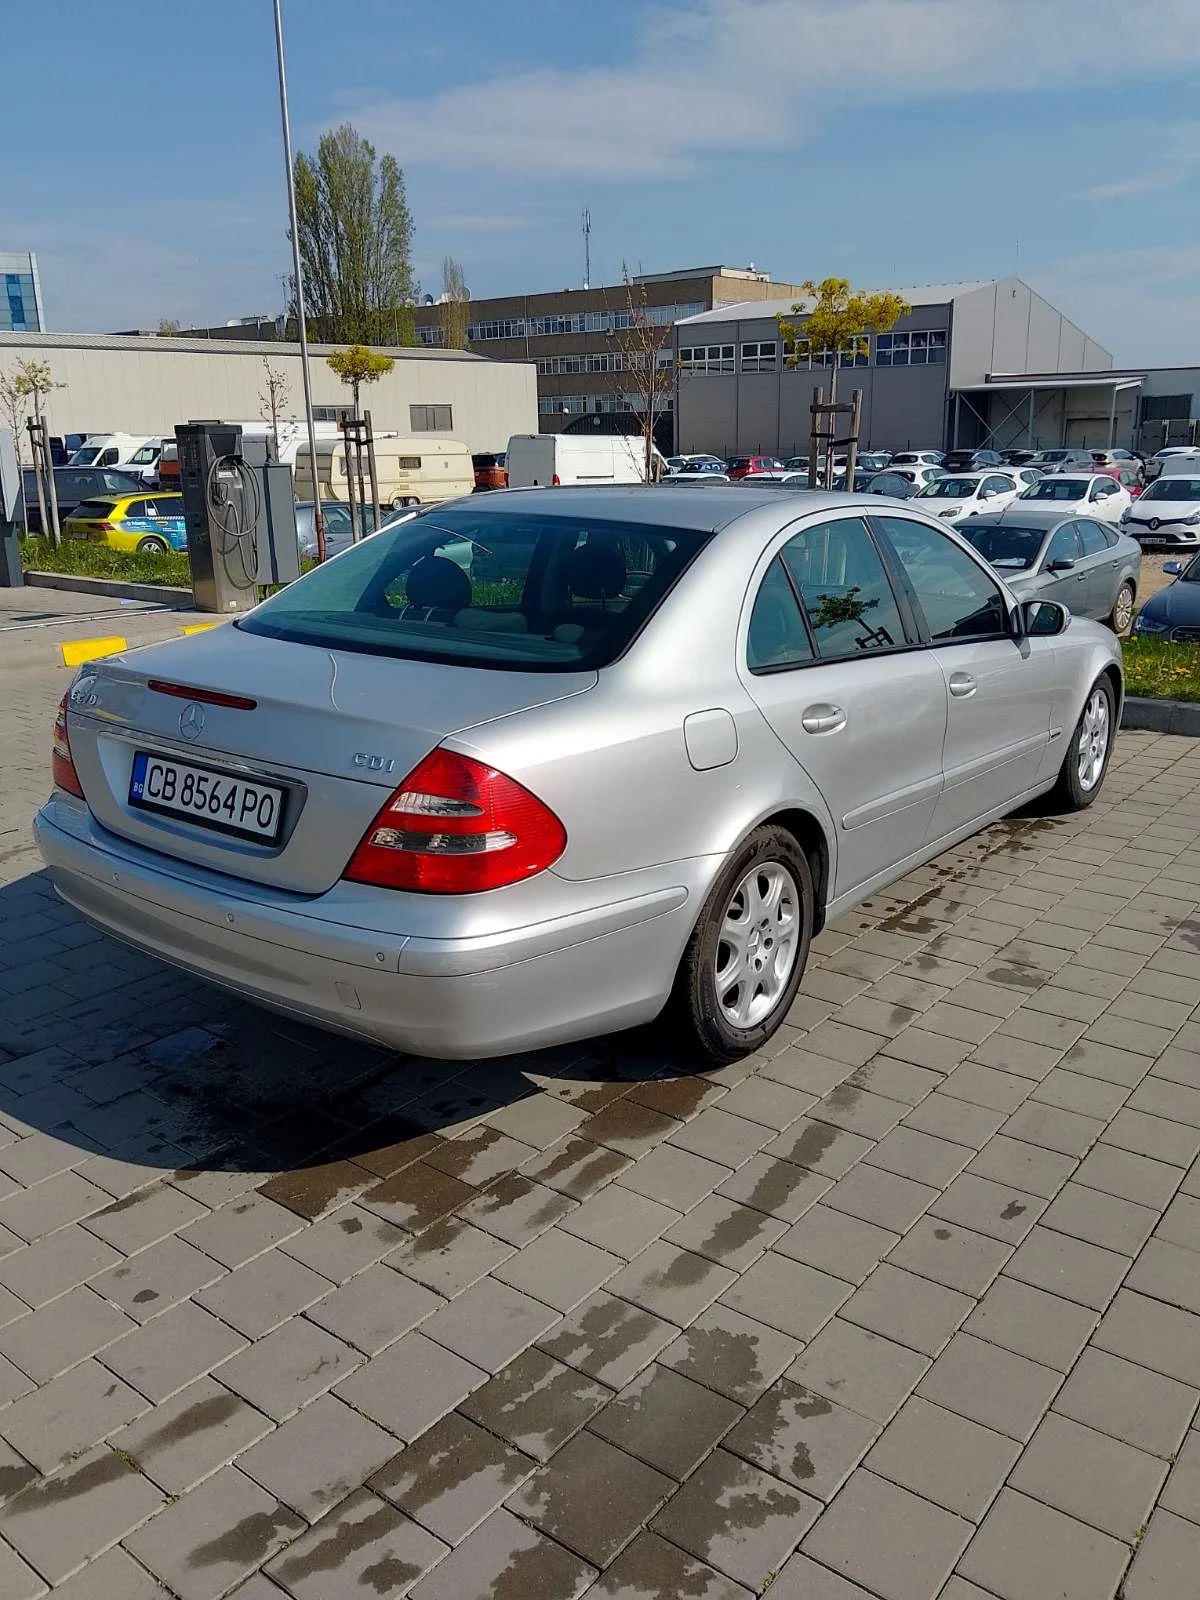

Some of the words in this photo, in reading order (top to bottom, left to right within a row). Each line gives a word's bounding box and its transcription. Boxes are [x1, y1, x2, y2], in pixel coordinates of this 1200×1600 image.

[352, 753, 395, 773] CDI
[133, 782, 143, 793] BG
[147, 765, 177, 801] CB
[180, 773, 238, 819] 8564
[239, 788, 274, 828] PO
